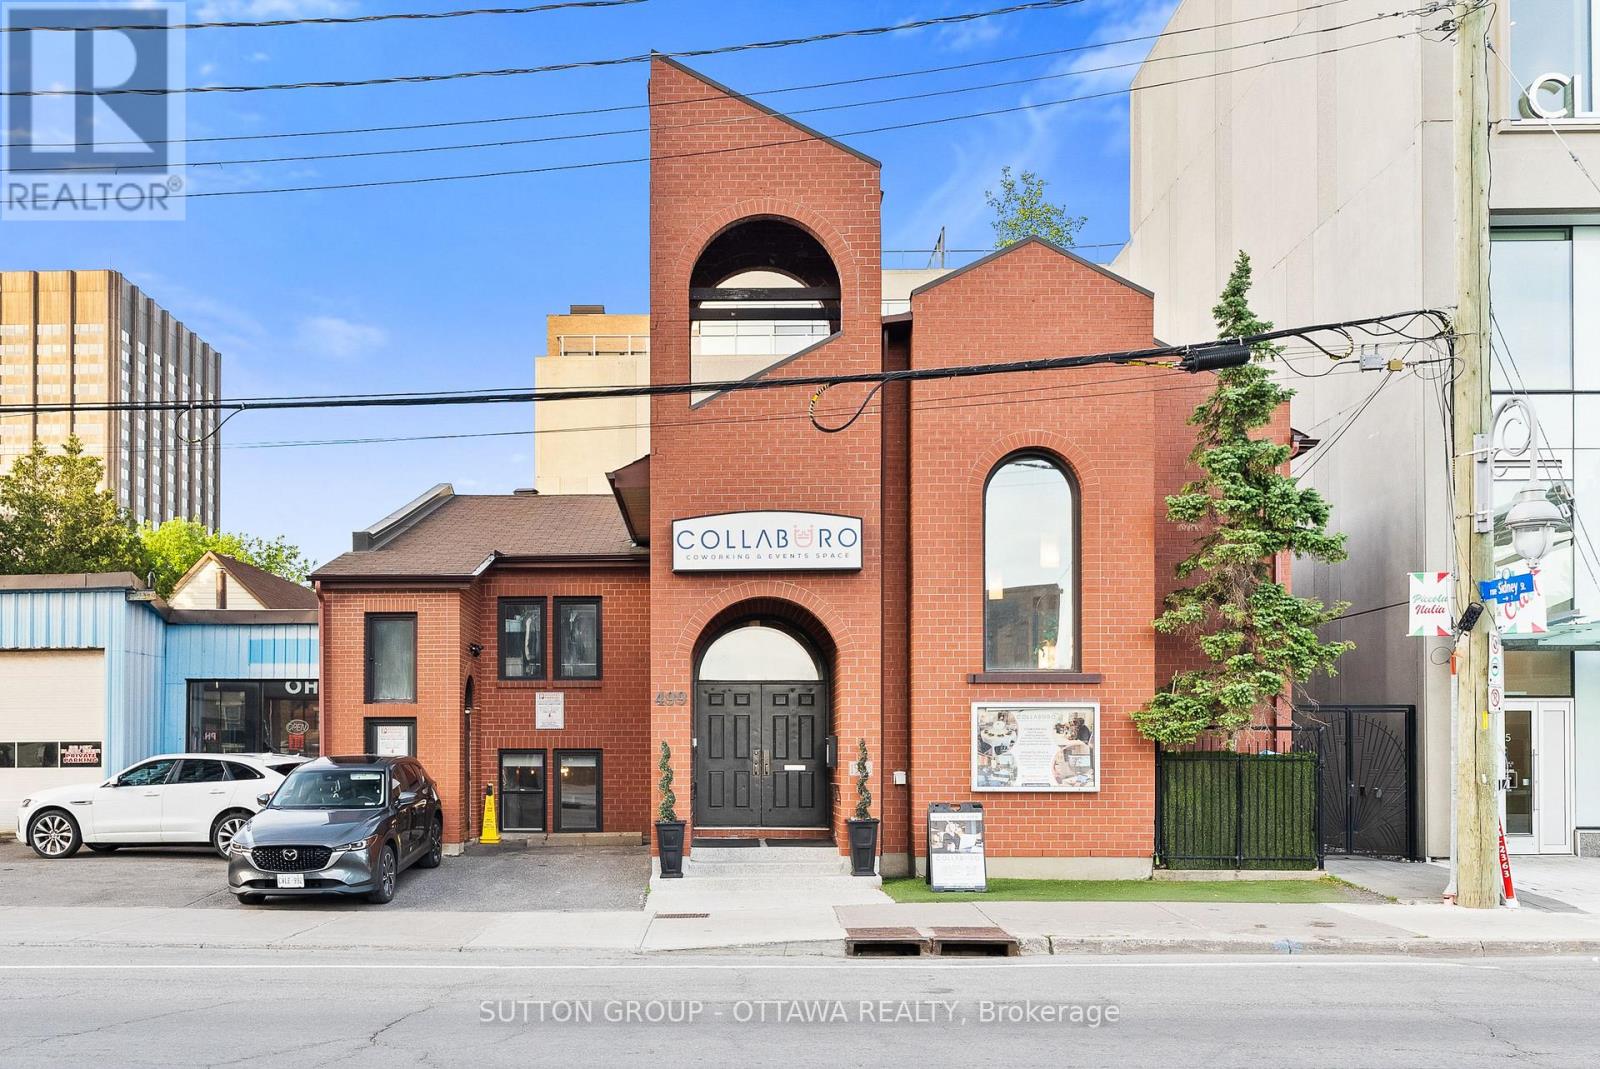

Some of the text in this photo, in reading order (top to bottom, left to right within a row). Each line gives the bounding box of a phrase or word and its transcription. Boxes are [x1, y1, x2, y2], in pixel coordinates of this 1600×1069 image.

[686, 553, 750, 561] COWORKING
[768, 552, 809, 560] EVENTS
[1498, 580, 1518, 596] Sidney
[1415, 604, 1446, 615] Italia
